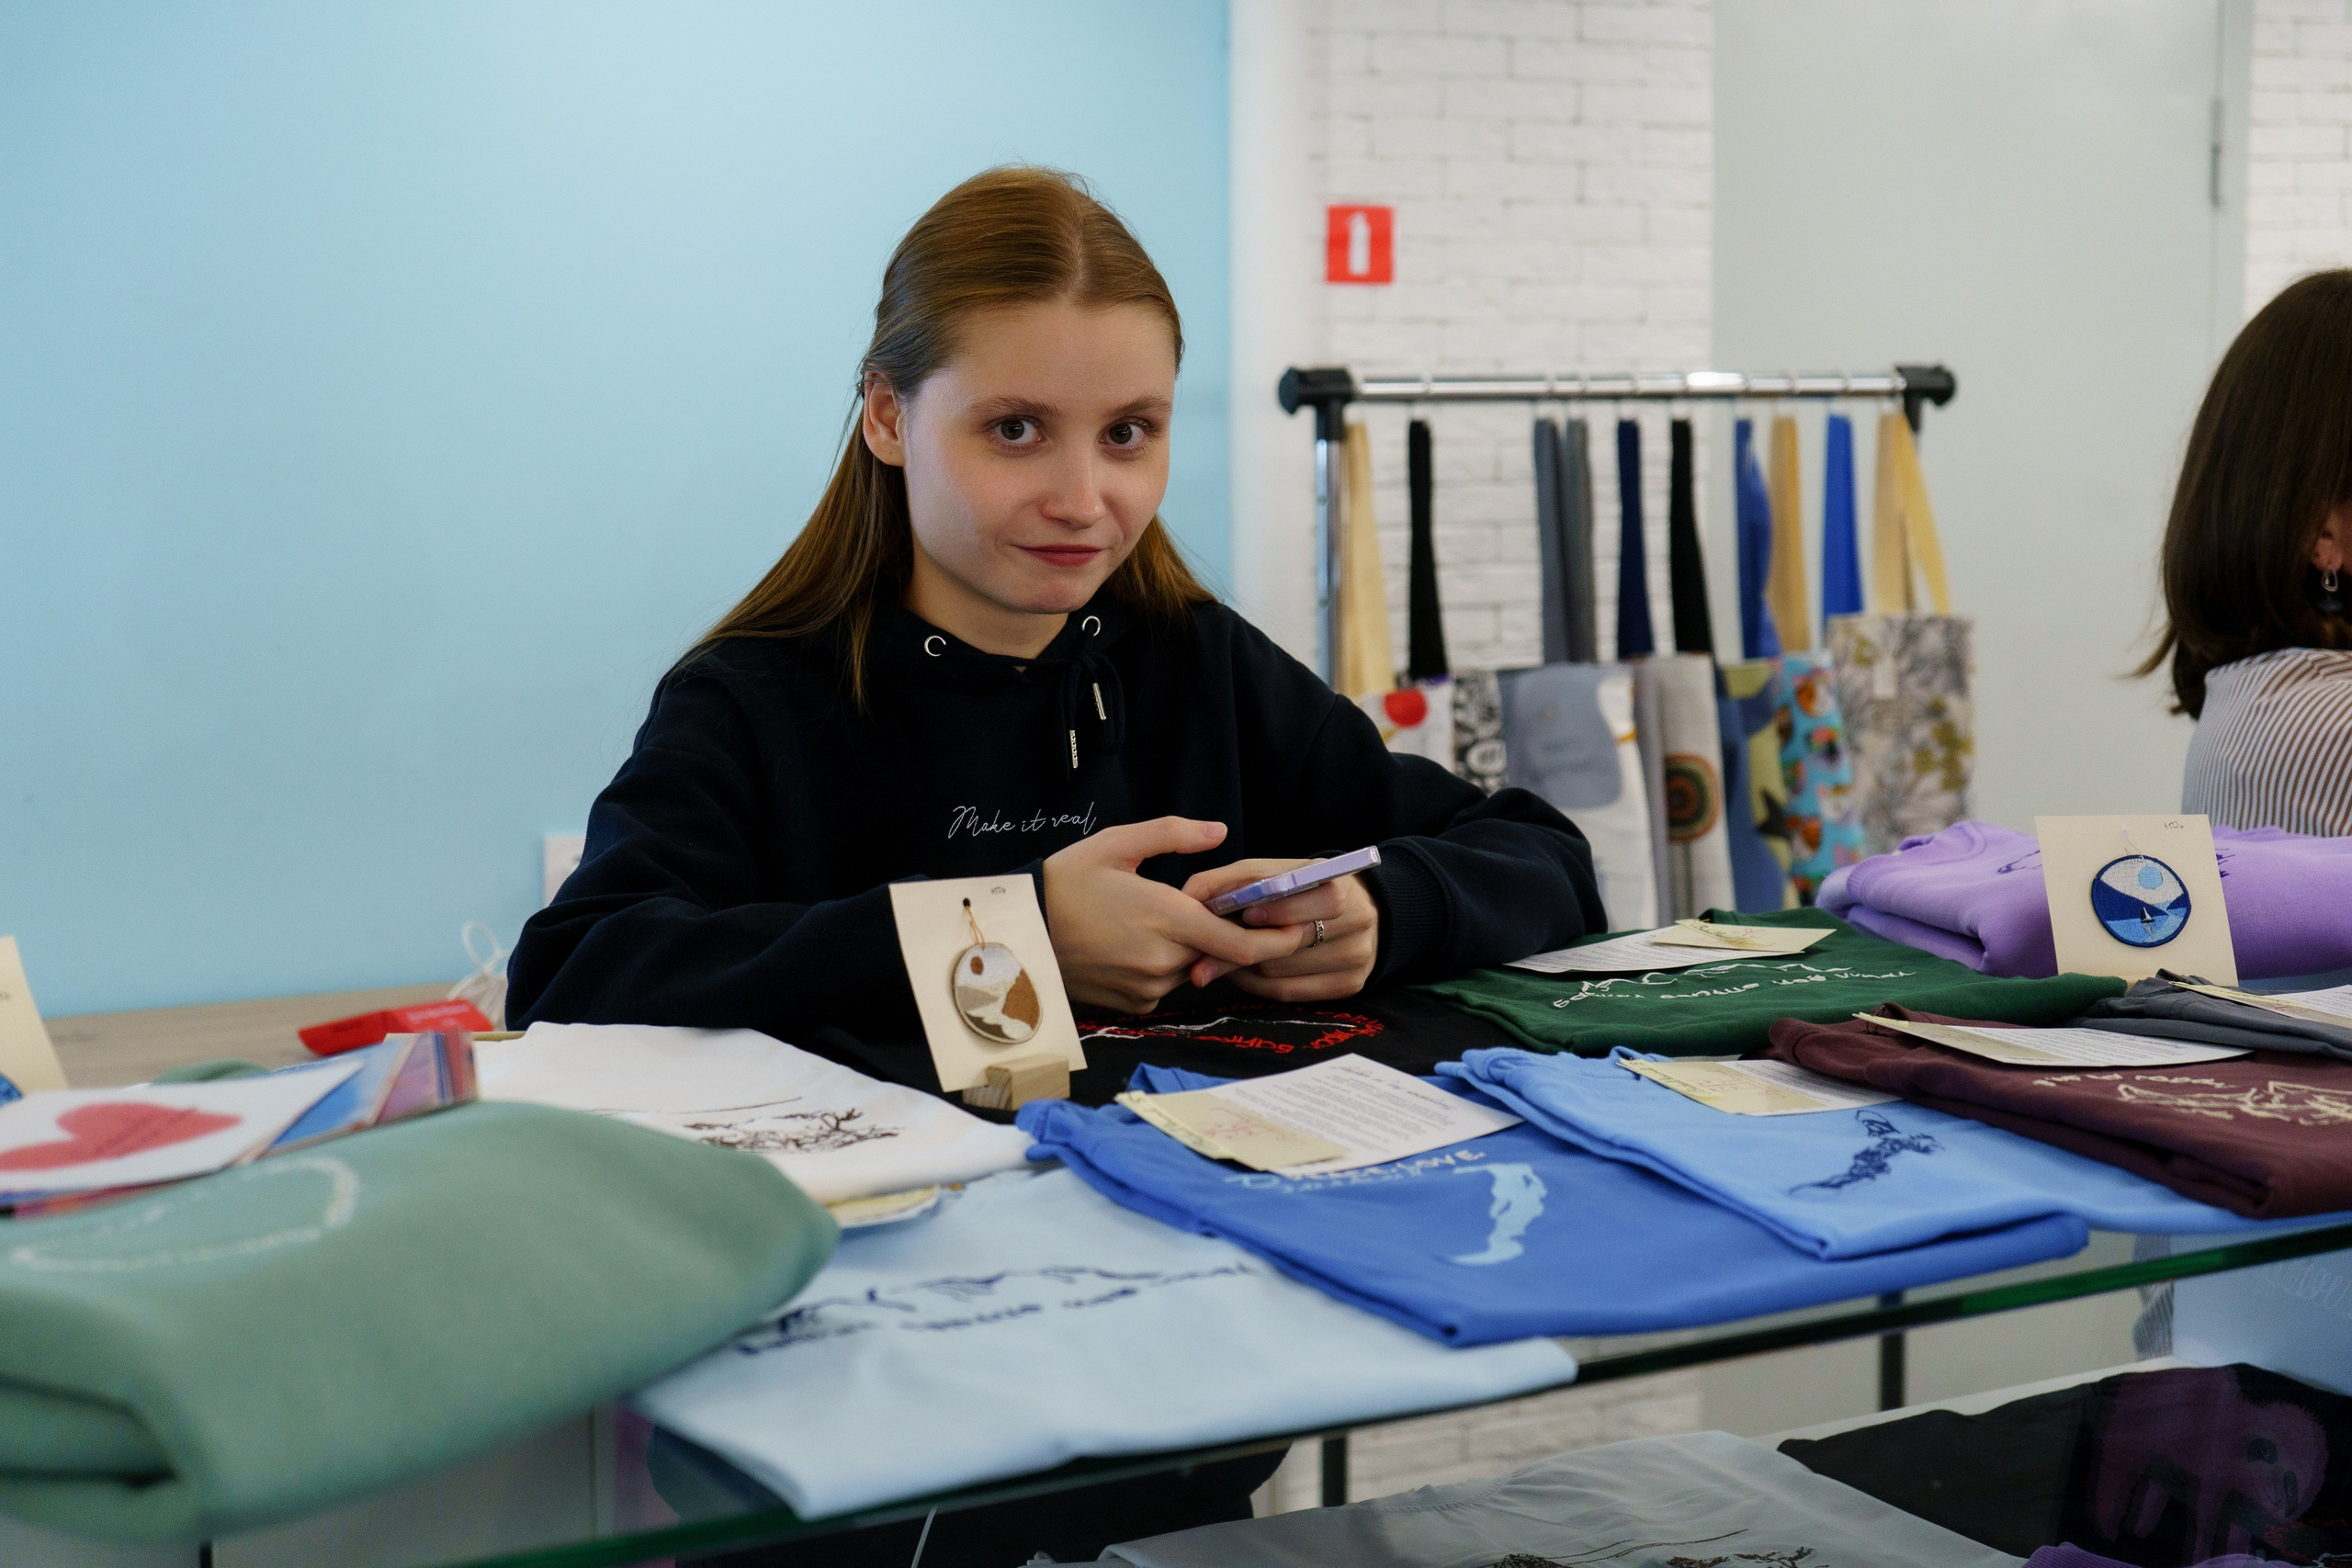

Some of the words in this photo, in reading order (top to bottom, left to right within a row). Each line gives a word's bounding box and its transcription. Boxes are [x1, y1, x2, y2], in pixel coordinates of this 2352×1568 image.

[947, 805, 1016, 840] Make
[1021, 808, 1047, 832] it
[1051, 801, 1097, 836] real
